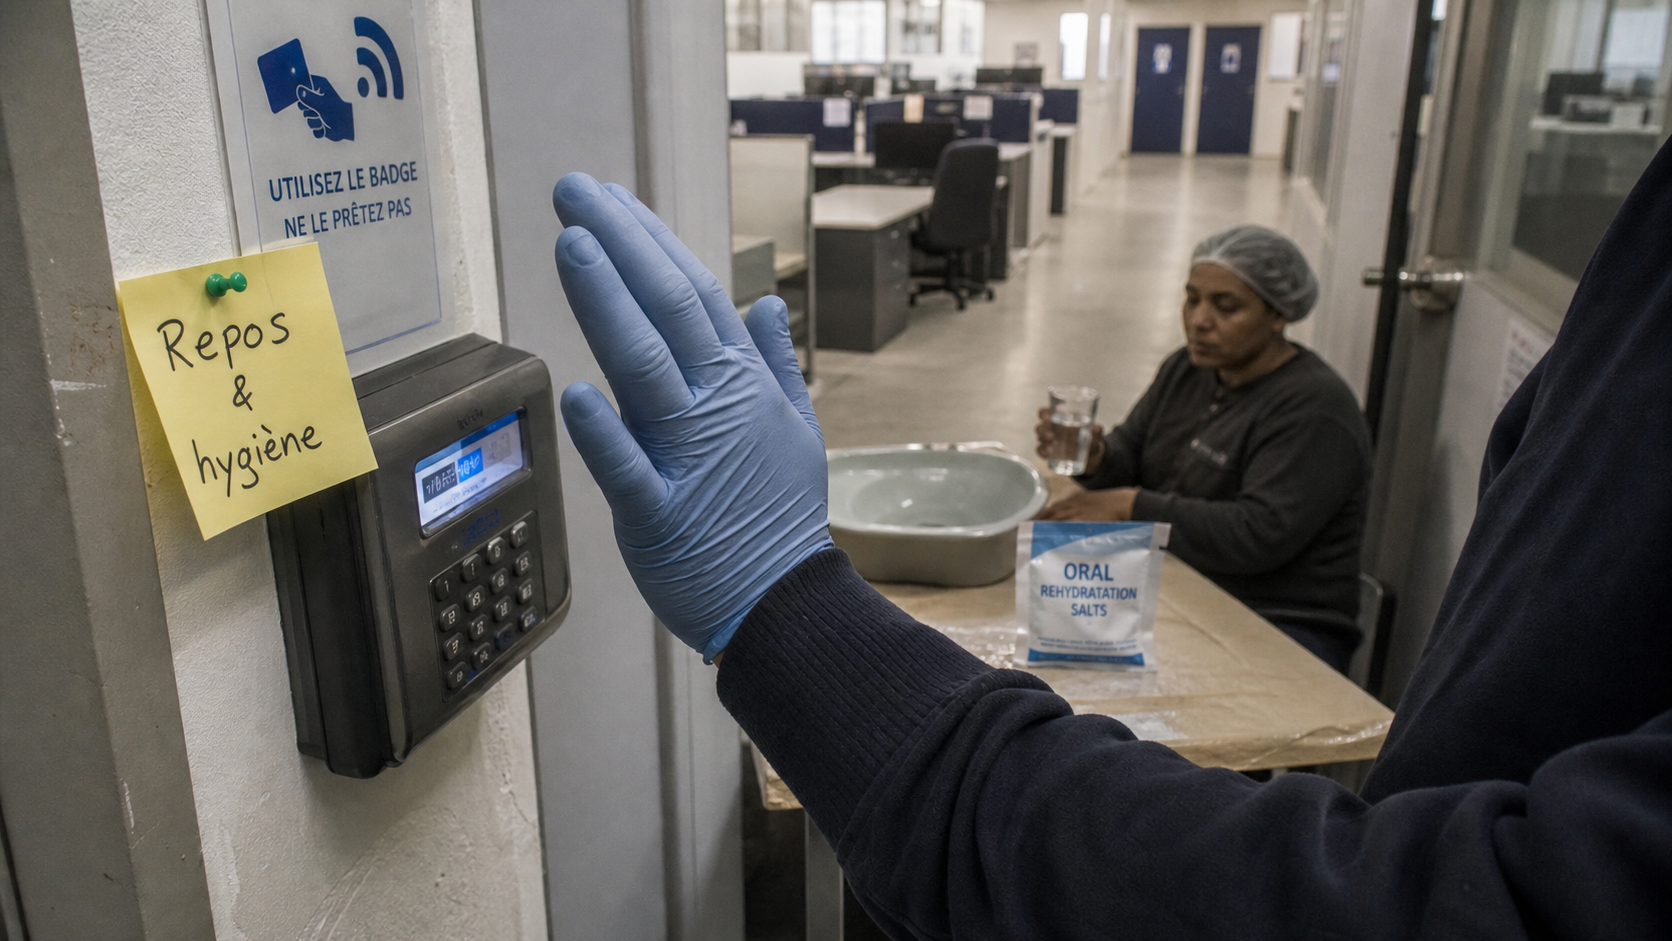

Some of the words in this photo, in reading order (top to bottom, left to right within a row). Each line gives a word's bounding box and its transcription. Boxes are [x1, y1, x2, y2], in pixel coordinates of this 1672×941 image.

[269, 171, 343, 202] UTILISEZ
[347, 168, 366, 191] LE
[369, 161, 418, 185] BADGE
[284, 215, 307, 239] NE
[310, 211, 328, 234] LE
[333, 201, 385, 230] PRÊTEZ
[388, 197, 412, 221] PAS
[157, 312, 290, 371] Repos
[232, 374, 253, 411] &
[191, 424, 323, 497] hygiène
[1064, 562, 1114, 581] ORAL
[1040, 584, 1137, 600] REHYDRATATION
[1071, 603, 1107, 617] SALTS
